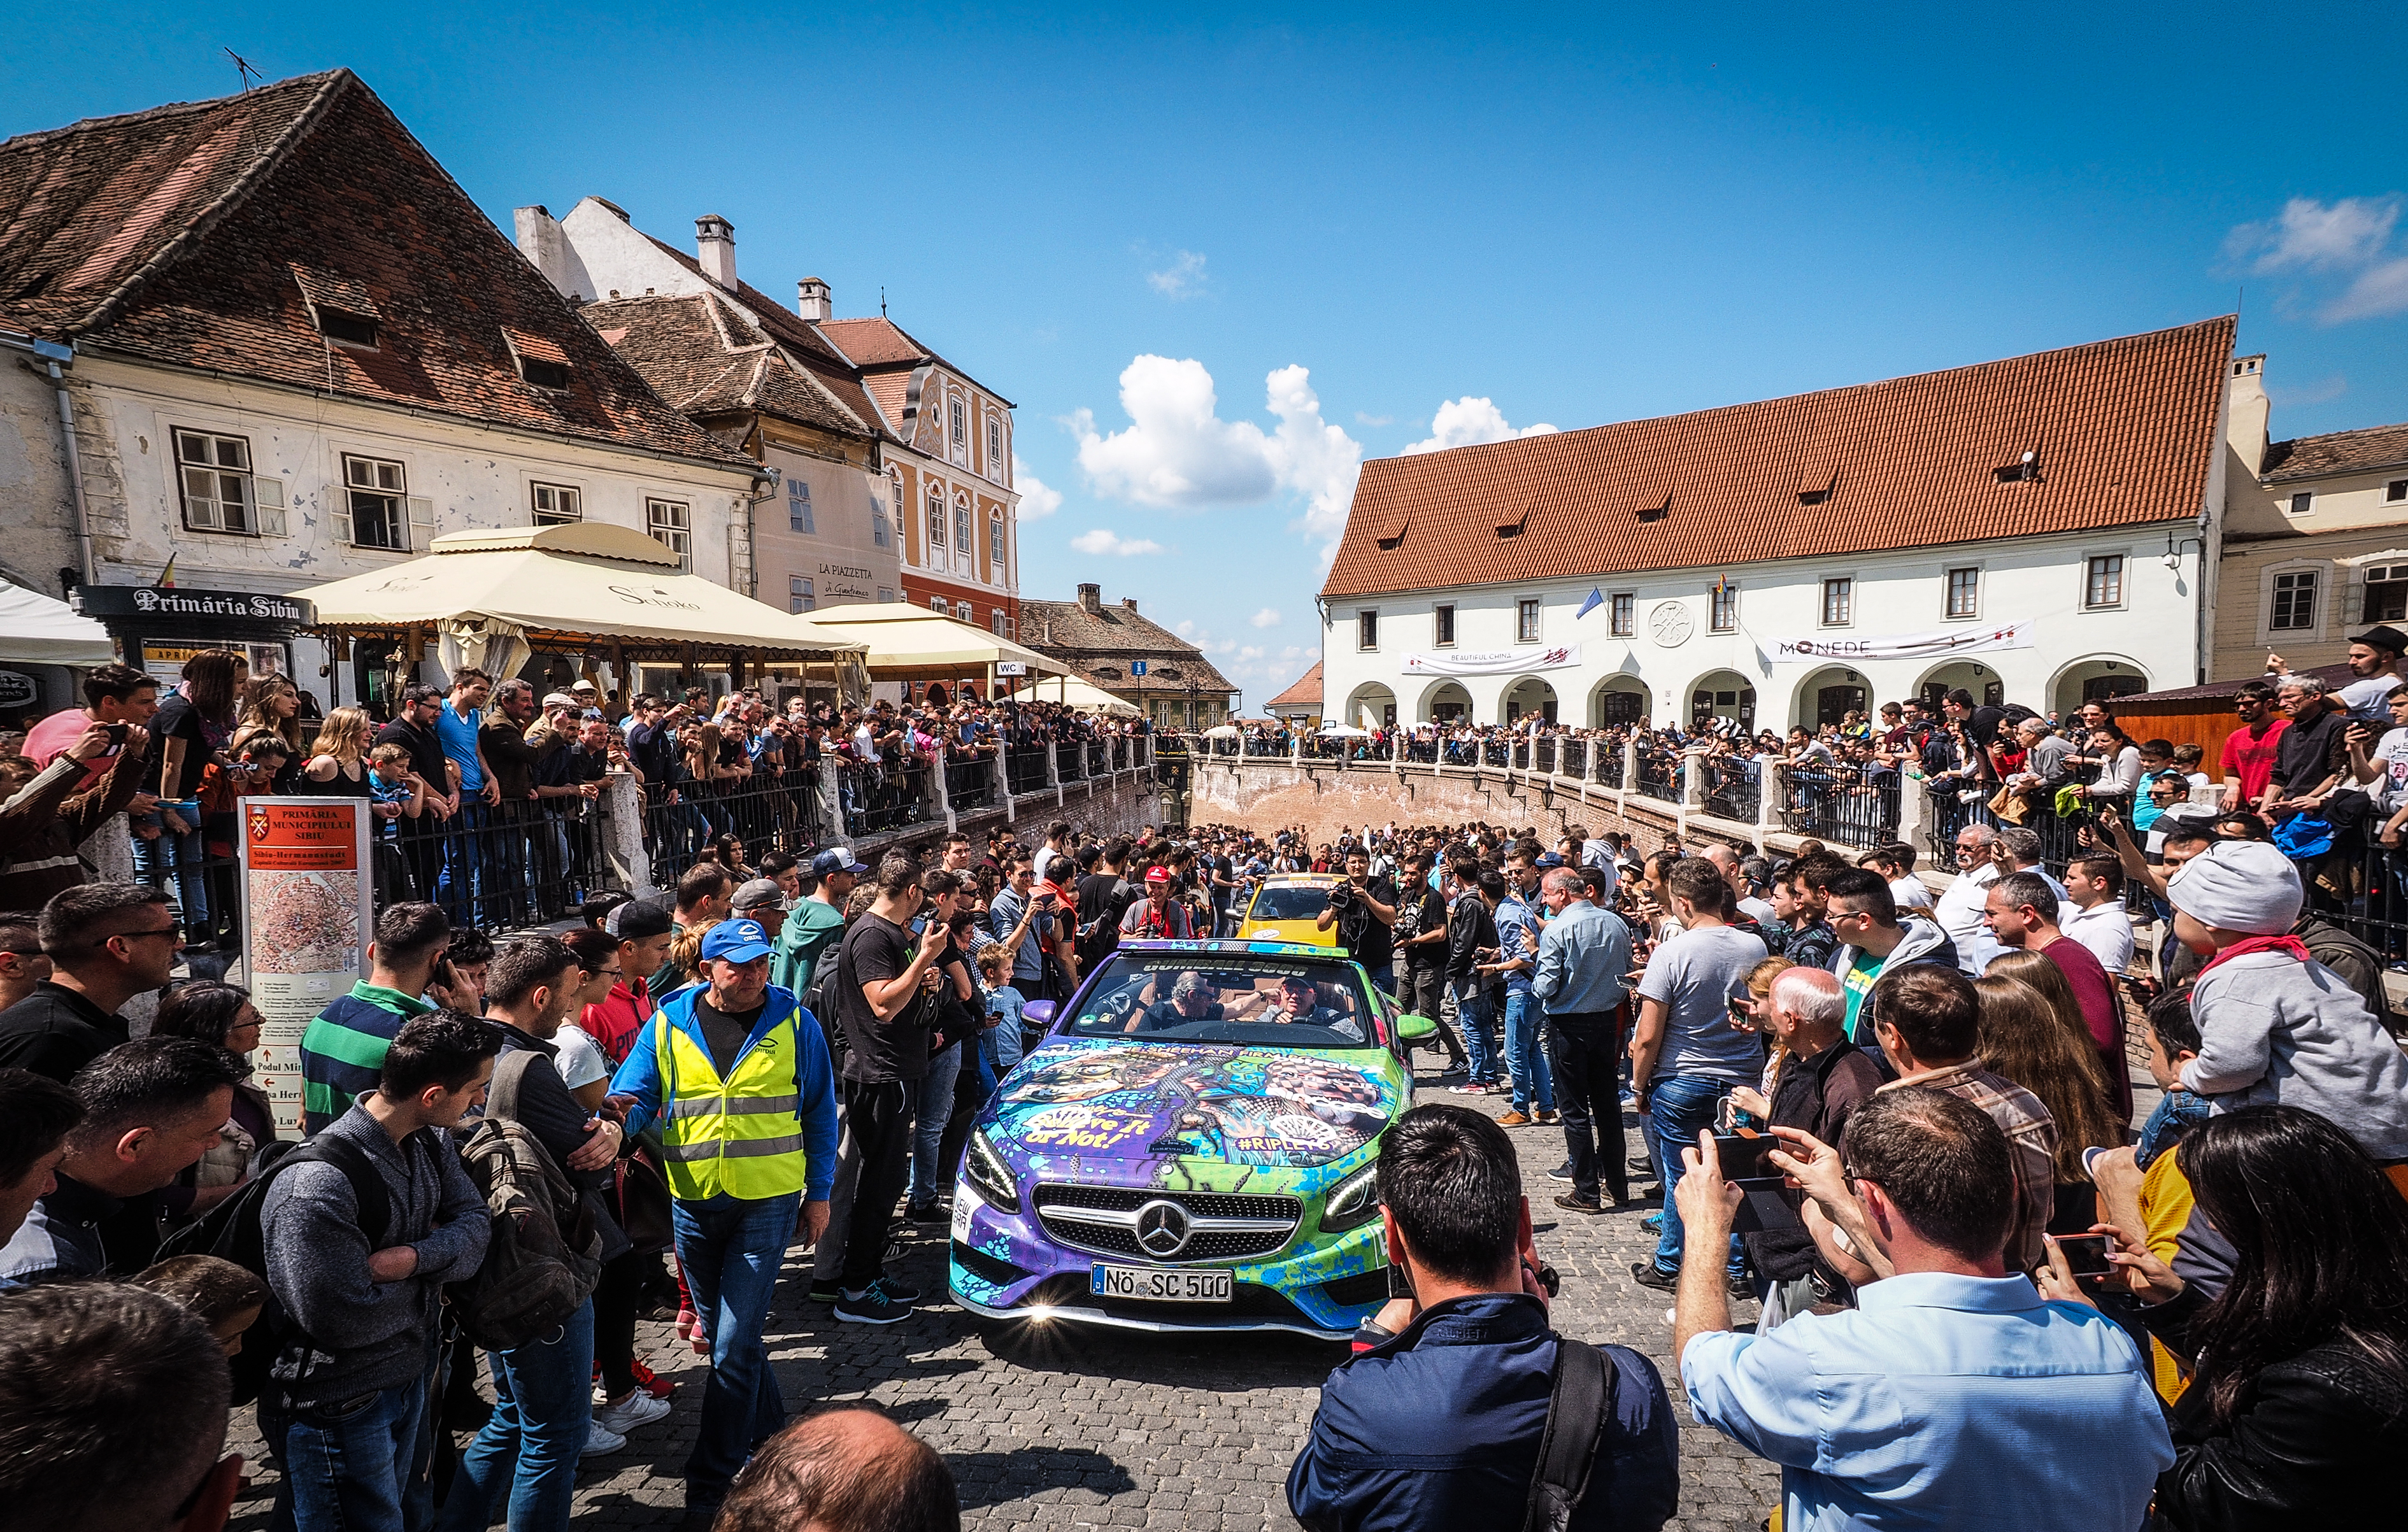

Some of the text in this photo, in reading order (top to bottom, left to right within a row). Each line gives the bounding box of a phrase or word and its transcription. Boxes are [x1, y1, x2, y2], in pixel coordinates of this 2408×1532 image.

[819, 564, 873, 580] LA PIAZZETTA
[608, 586, 701, 610] Schoko
[250, 596, 301, 620] Sibiu
[1779, 640, 1871, 655] MONEDE
[273, 821, 351, 829] MUNICIPIULUI
[295, 832, 325, 840] SIBIU
[1143, 959, 1246, 972] GUMBALL
[615, 1026, 638, 1058] PU
[1241, 1051, 1282, 1059] FIRM
[258, 1062, 281, 1071] Podul
[1119, 1119, 1151, 1135] It
[1025, 1130, 1131, 1149] or Not!
[1106, 1270, 1229, 1297] NÖ SC 500
